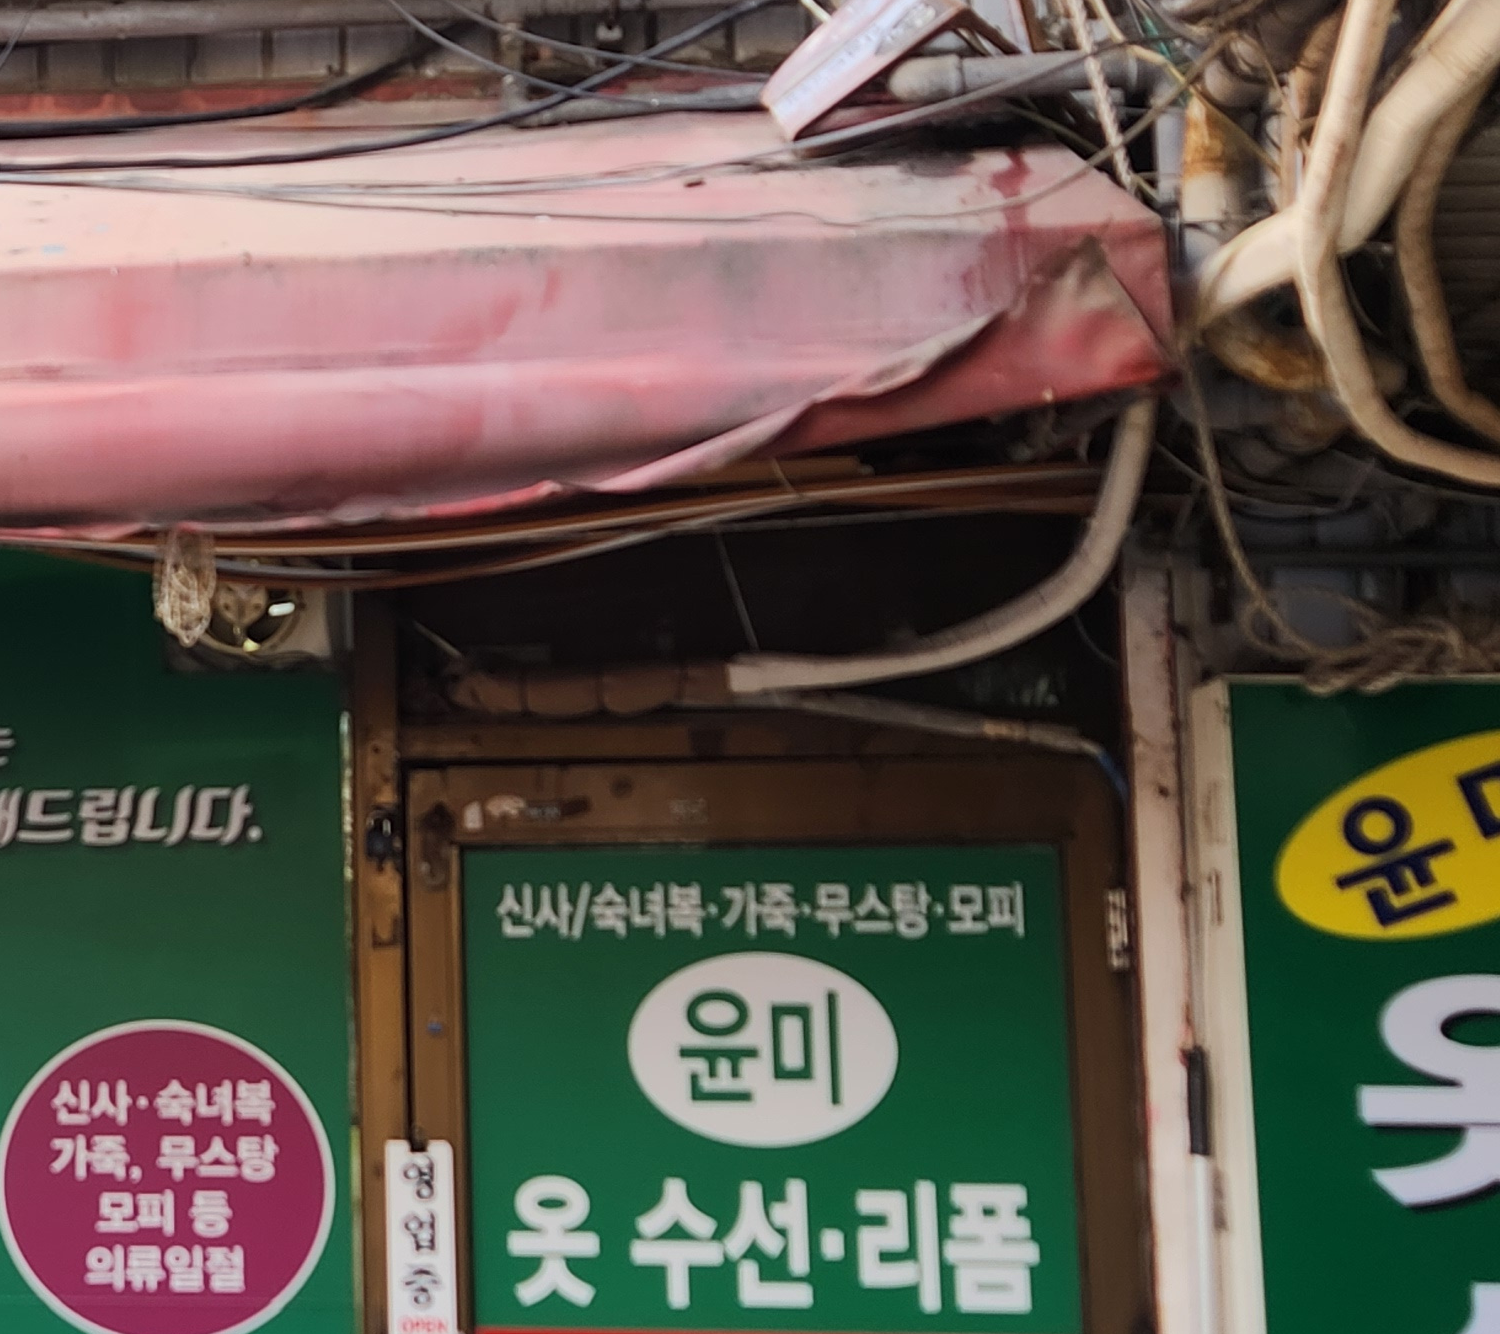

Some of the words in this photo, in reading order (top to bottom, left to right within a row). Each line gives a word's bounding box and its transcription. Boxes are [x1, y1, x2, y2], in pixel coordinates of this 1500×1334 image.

[679, 988, 843, 1107] 윤미
[156, 1133, 280, 1184] 무스탕
[94, 1188, 176, 1238] 모피
[188, 1189, 234, 1239] 등
[402, 1154, 443, 1311] 영업중
[84, 1244, 247, 1295] 의류일절
